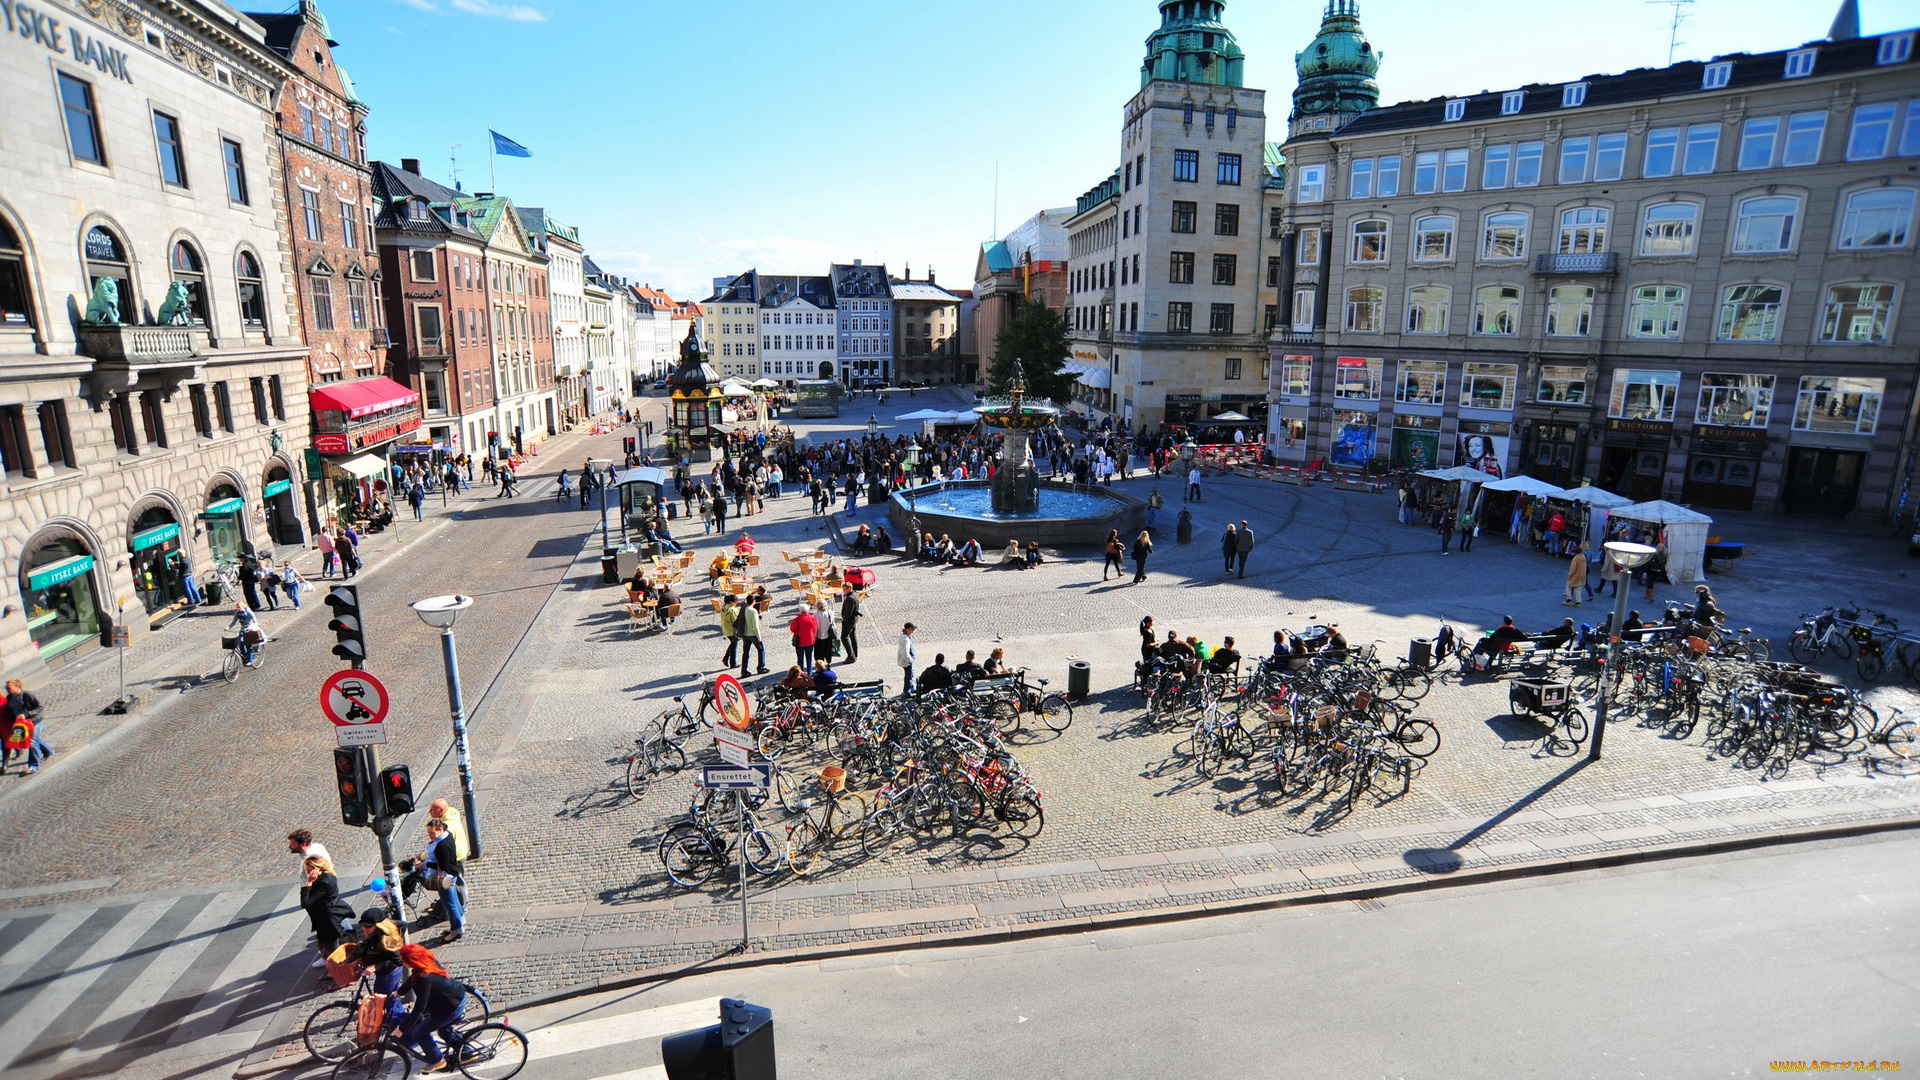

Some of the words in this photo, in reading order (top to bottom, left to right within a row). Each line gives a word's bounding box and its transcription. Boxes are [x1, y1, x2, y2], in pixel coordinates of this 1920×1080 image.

[0, 0, 66, 54] YSKE
[69, 27, 134, 84] BANK
[88, 244, 115, 258] TRAVEL
[1621, 422, 1664, 431] VICTORIA
[1708, 428, 1756, 438] VICTORIA
[149, 533, 164, 545] JYSKE
[164, 527, 176, 540] BANK
[51, 569, 72, 583] JYSKE
[72, 561, 89, 574] BANK
